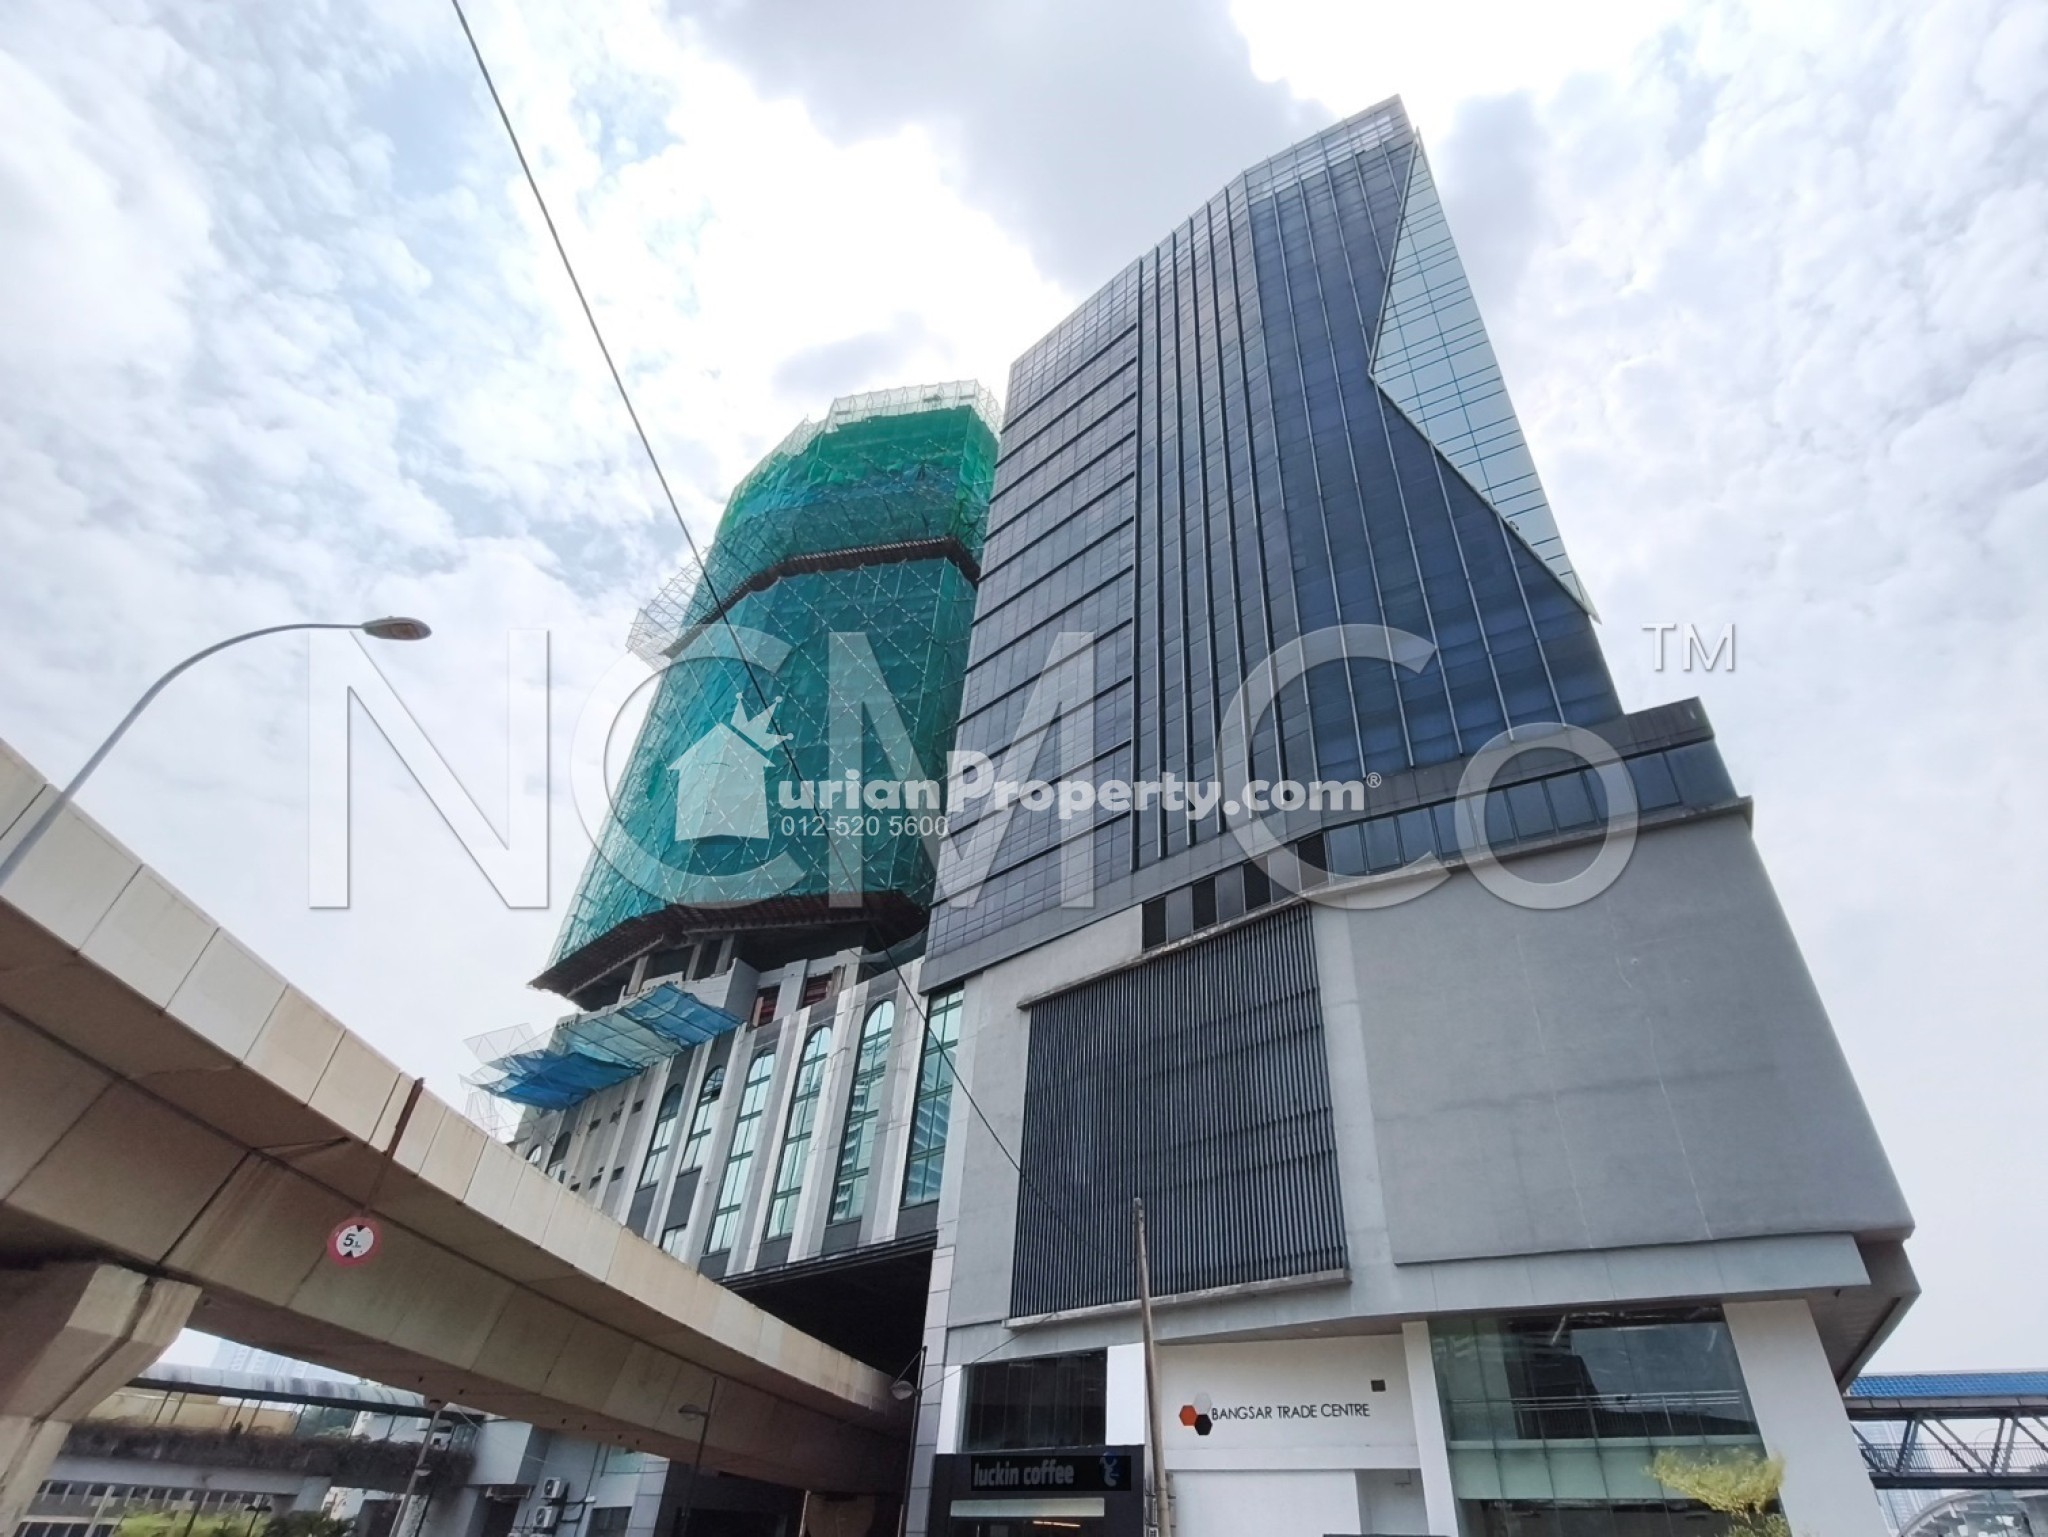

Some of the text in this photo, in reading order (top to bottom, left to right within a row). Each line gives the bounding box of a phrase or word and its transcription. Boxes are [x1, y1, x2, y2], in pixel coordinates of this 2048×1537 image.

[1211, 1402, 1371, 1420] BANGSAR TRADE CENTRE
[974, 1459, 1074, 1487] luckin coffee
